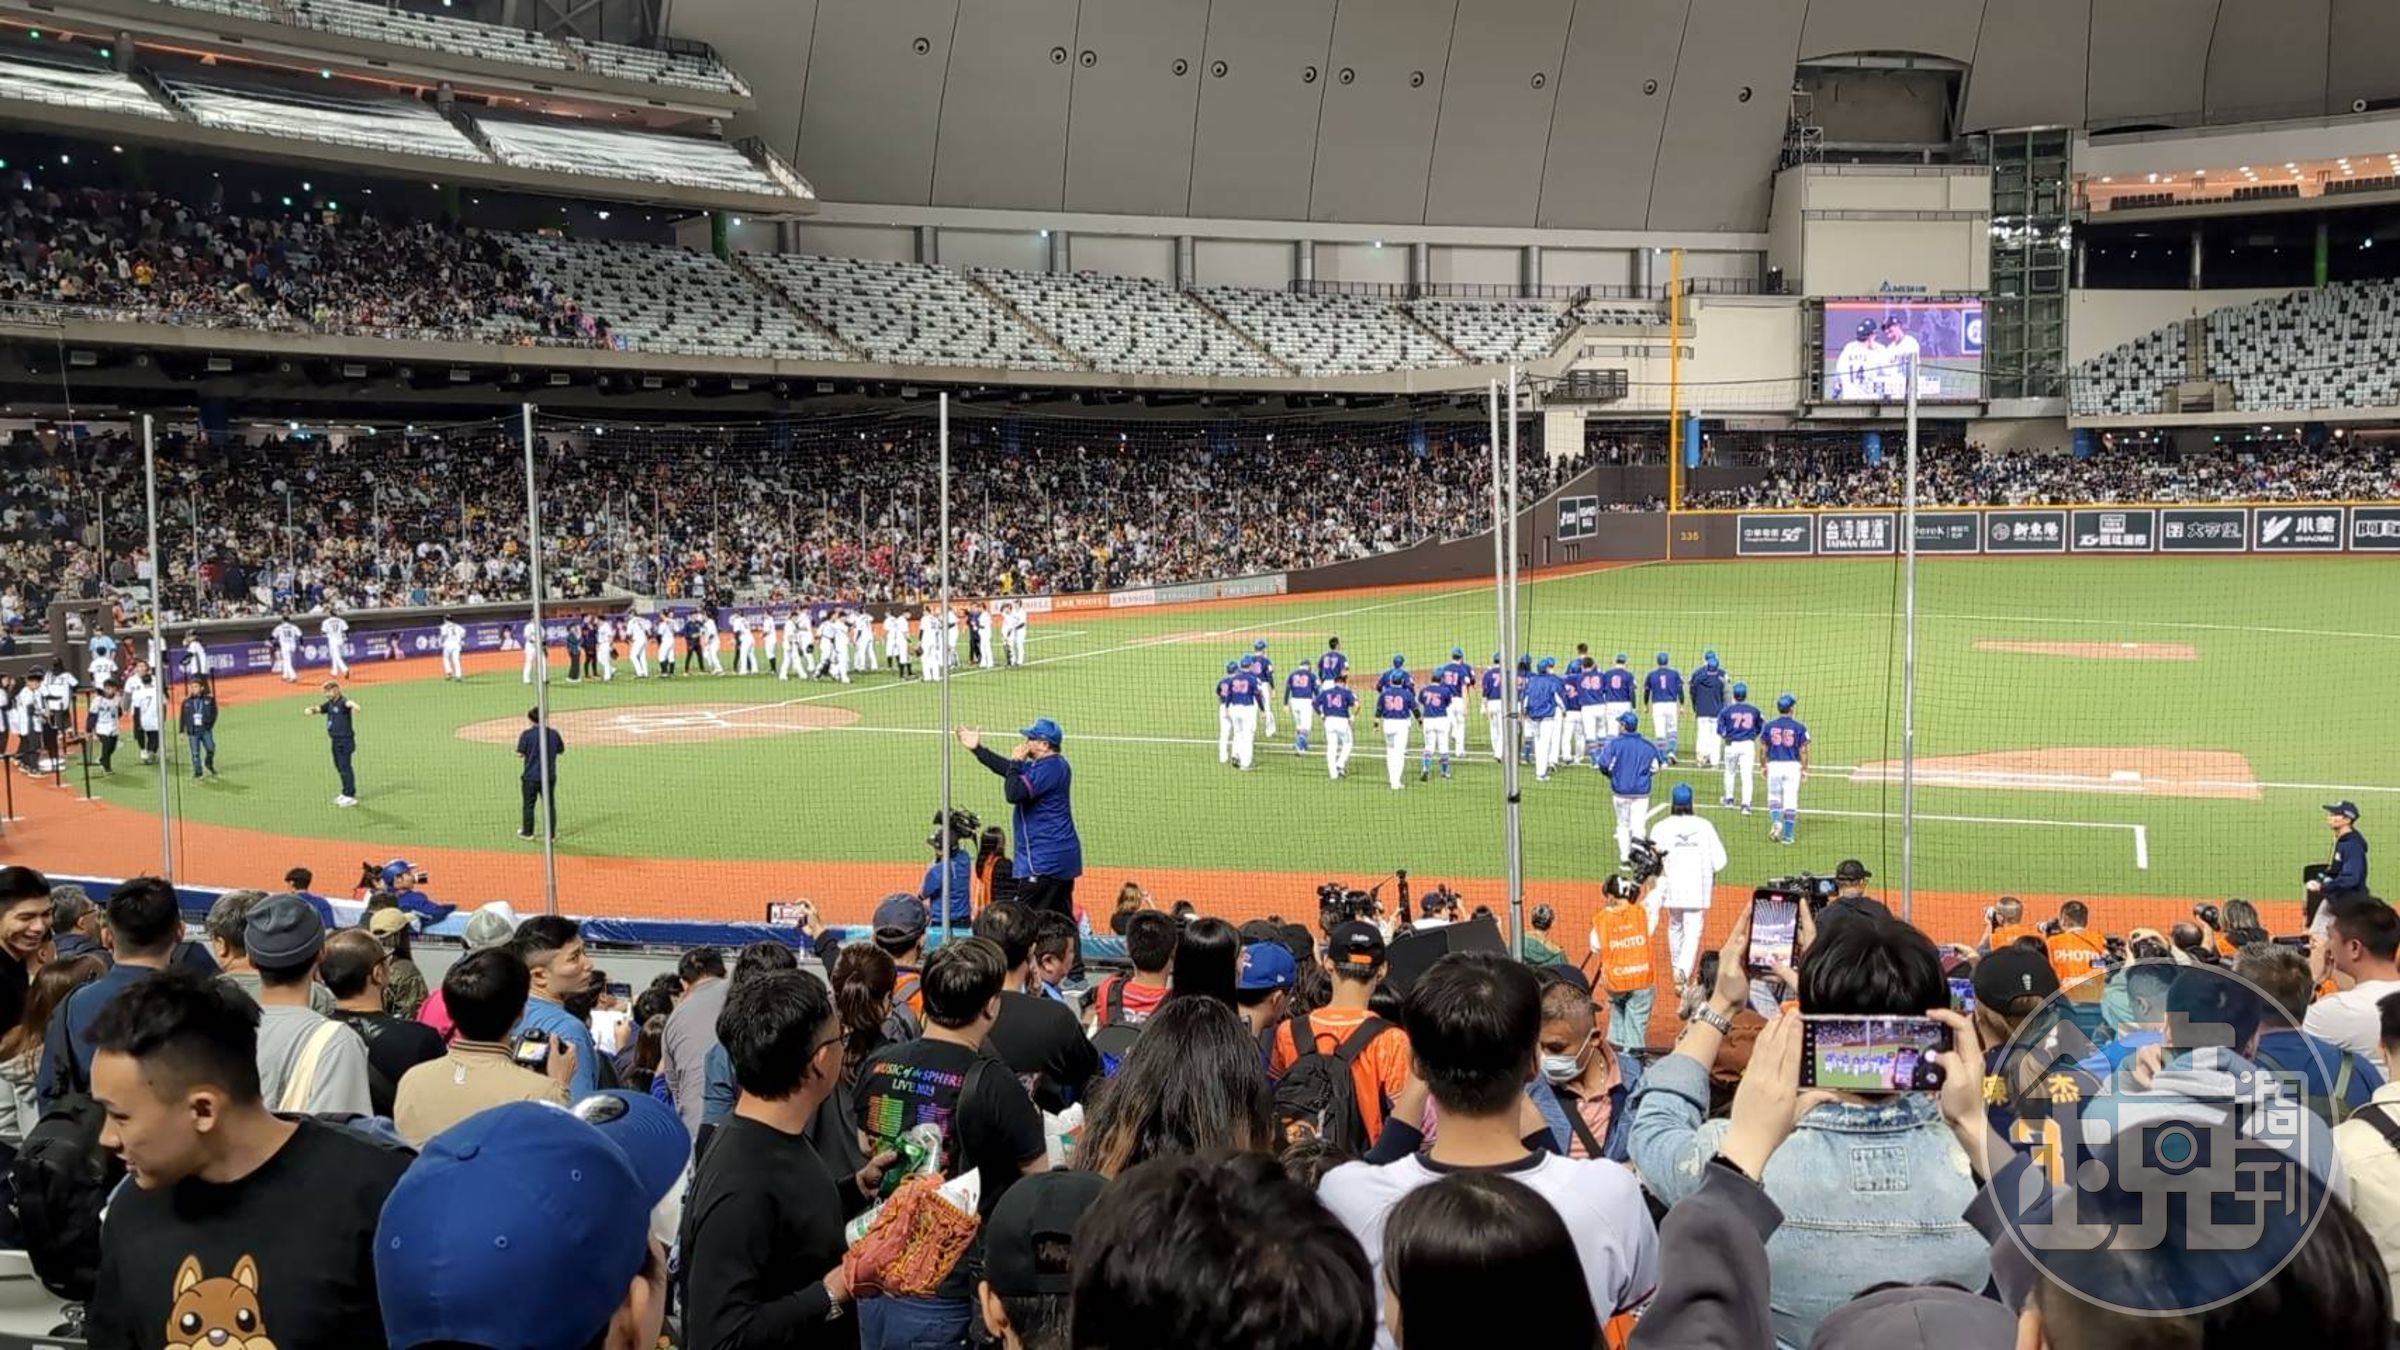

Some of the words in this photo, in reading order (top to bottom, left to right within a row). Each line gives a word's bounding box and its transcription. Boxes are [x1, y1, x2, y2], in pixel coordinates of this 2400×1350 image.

[1850, 365, 1865, 383] 14
[1825, 519, 1885, 540] 台灣啤酒
[2013, 522, 2059, 536] 新東陽
[2296, 516, 2335, 533] 小美
[1681, 531, 1699, 541] 335
[1780, 527, 1806, 542] 5G
[1826, 540, 1858, 548] TAIWAN
[1860, 540, 1884, 548] BEER
[1660, 675, 1667, 688] 1
[1326, 694, 1342, 708] 14
[1609, 934, 1645, 951] PHOTO
[873, 1062, 903, 1076] MUSIC
[903, 1066, 914, 1078] of
[922, 1070, 963, 1089] SPHERE
[892, 1079, 915, 1092] LIVE
